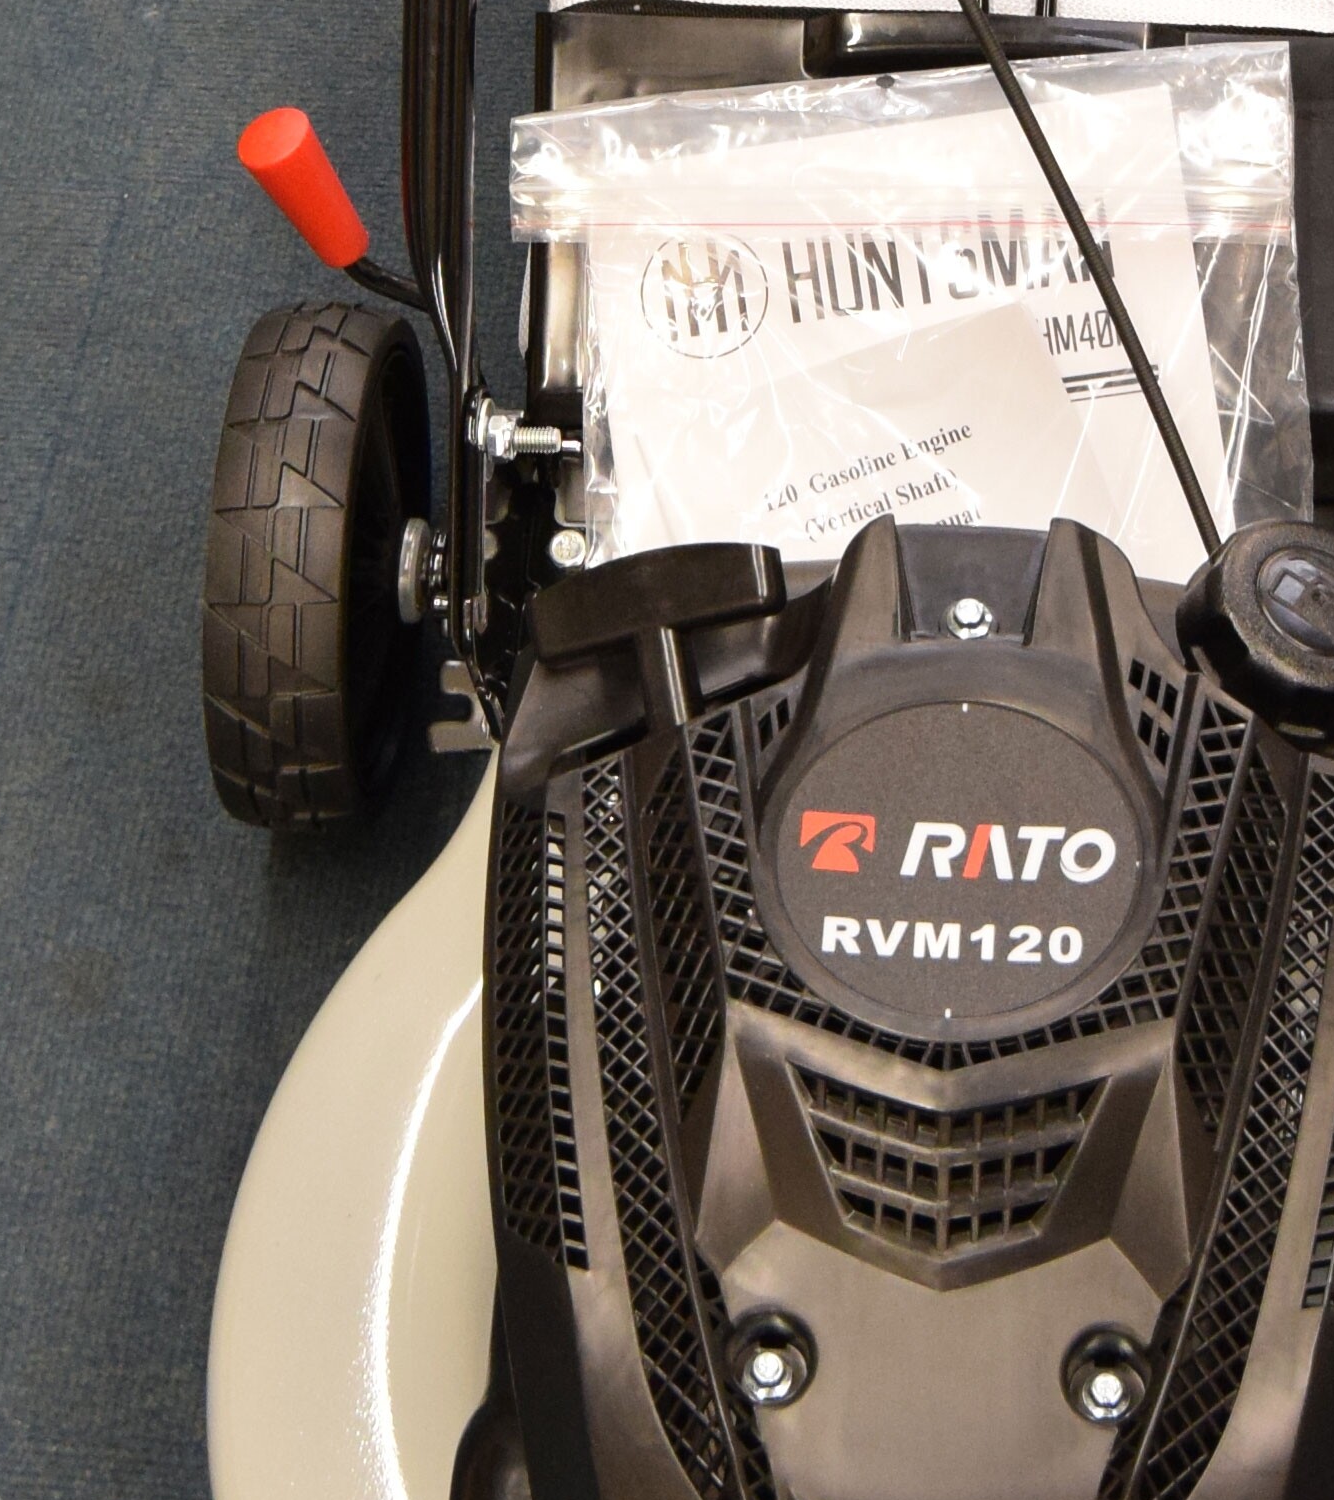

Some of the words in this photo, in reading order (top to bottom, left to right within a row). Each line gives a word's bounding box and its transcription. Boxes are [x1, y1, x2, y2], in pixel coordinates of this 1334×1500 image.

[1041, 308, 1123, 356] HM40
[809, 455, 897, 494] Gasoline
[901, 424, 972, 461] Engine
[900, 821, 1116, 883] RATO
[821, 916, 1083, 964] RVM120
